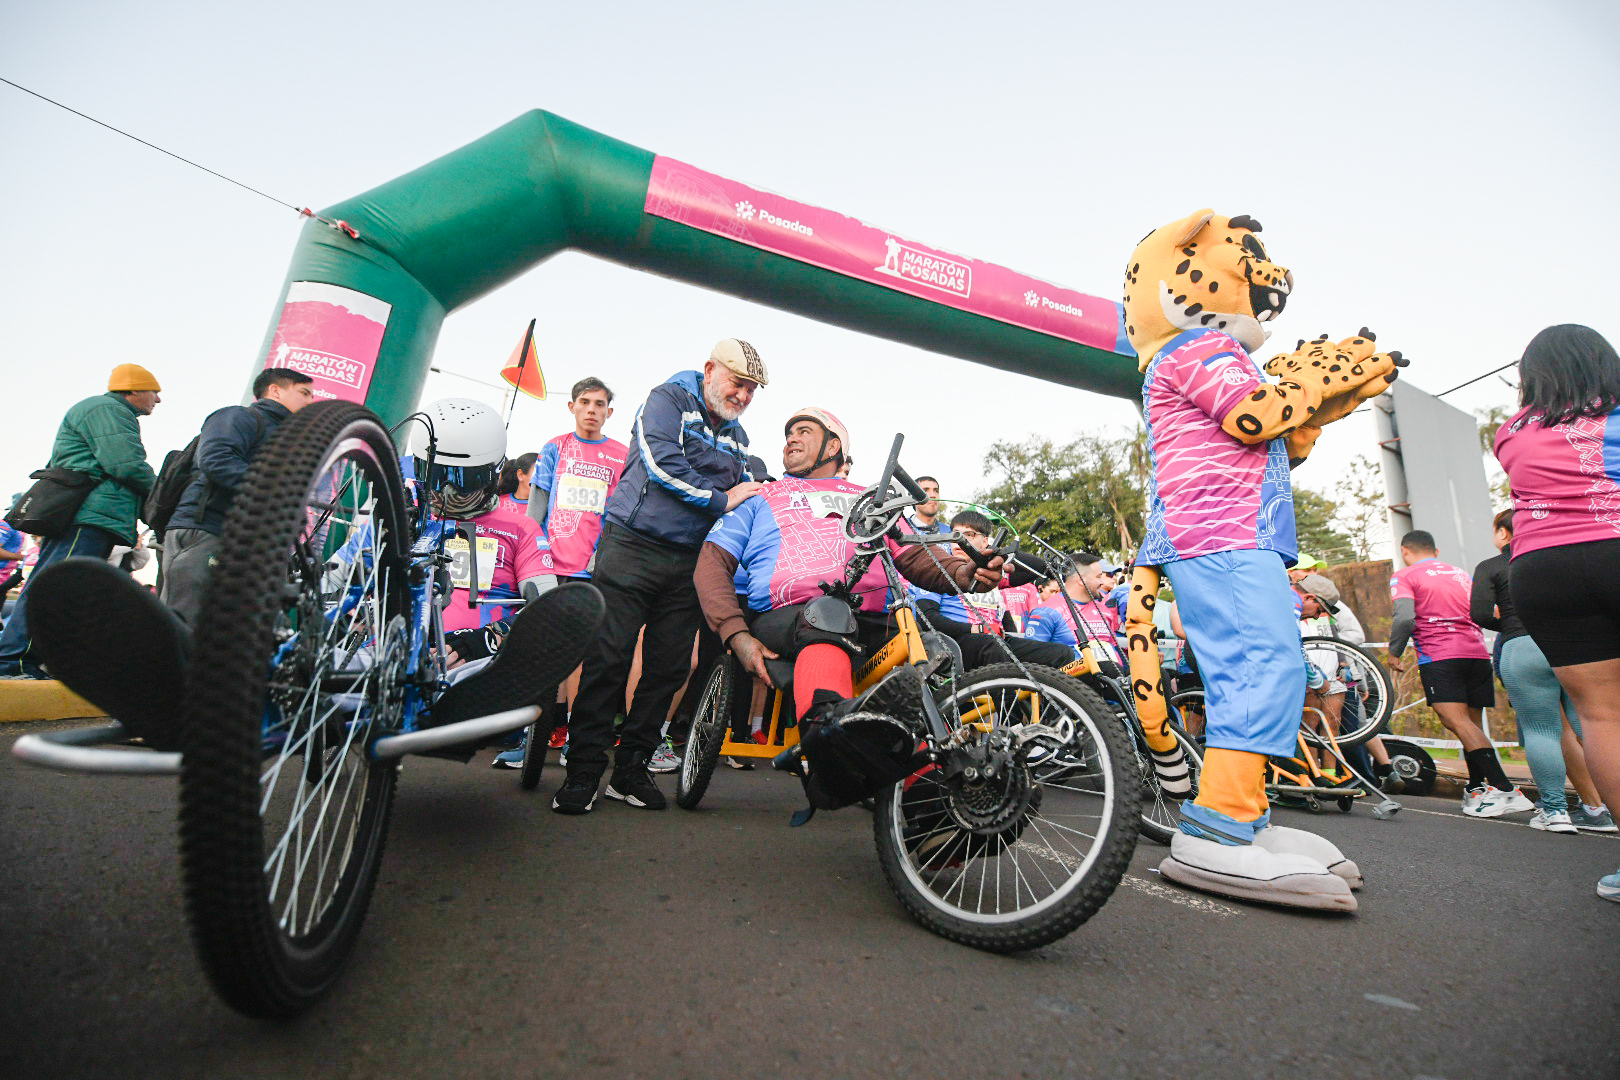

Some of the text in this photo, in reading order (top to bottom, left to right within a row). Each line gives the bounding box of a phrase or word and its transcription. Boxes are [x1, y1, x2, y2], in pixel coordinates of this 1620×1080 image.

[759, 209, 813, 236] Posadas
[903, 251, 966, 279] MARATÓN
[901, 261, 965, 291] POSADAS
[1042, 297, 1083, 317] Posadas
[287, 361, 355, 383] POSADAS
[290, 351, 358, 373] MARATÓN
[575, 469, 610, 481] POSADAS
[576, 463, 610, 475] MARATÓN
[567, 487, 599, 506] 393
[488, 528, 518, 540] Posadas
[483, 542, 494, 551] 5K
